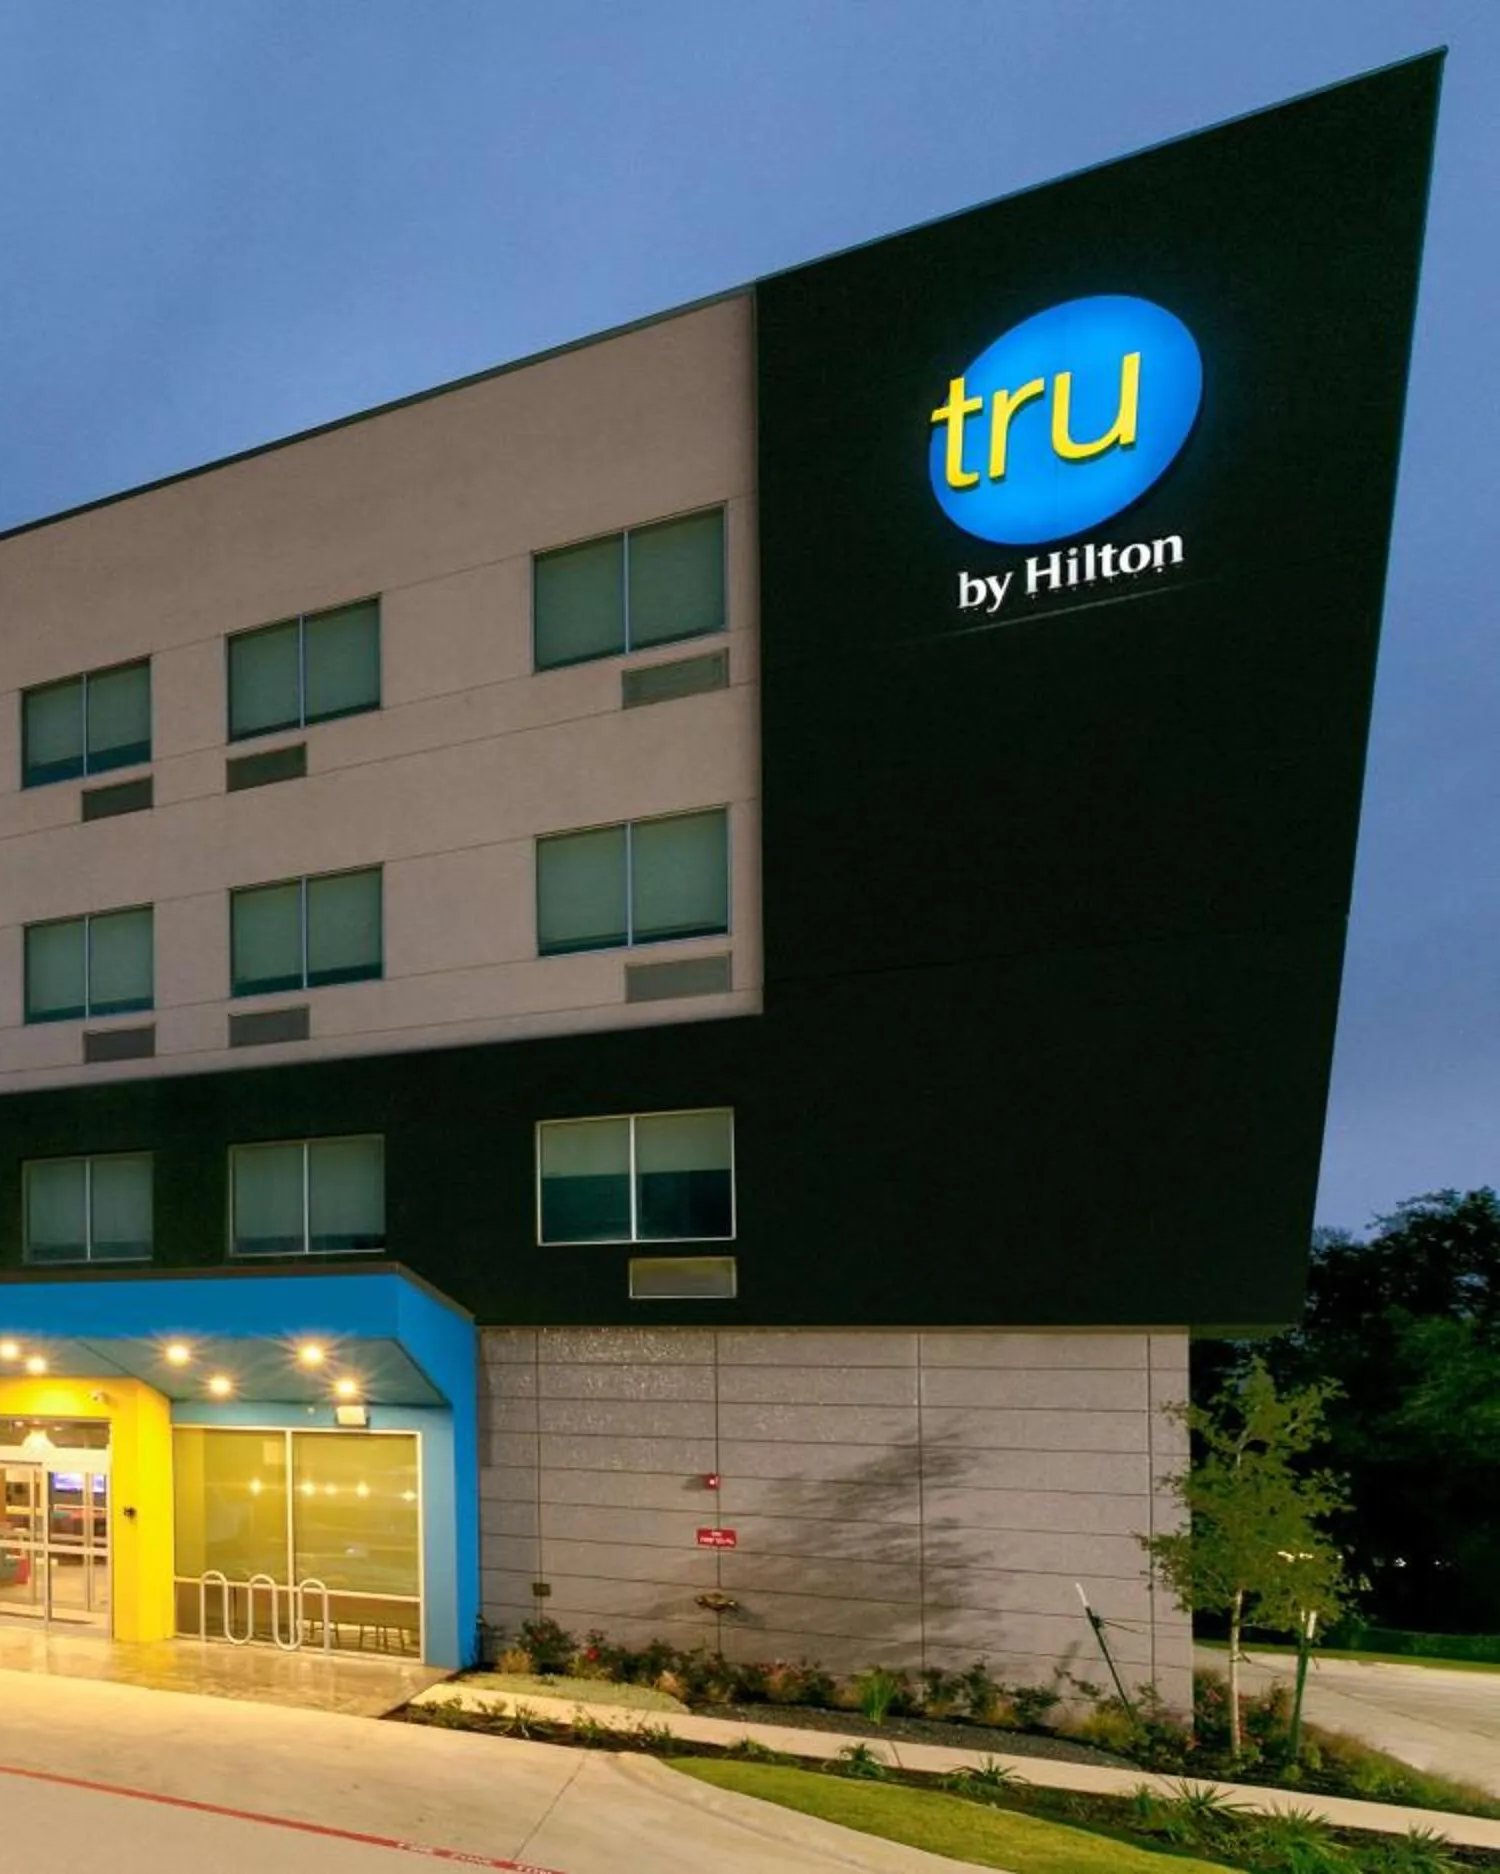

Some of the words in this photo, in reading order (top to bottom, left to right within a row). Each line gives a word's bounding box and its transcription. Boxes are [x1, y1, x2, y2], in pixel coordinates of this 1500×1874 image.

[930, 352, 1140, 488] tru
[957, 571, 1014, 612] by
[1025, 534, 1185, 595] Hilton
